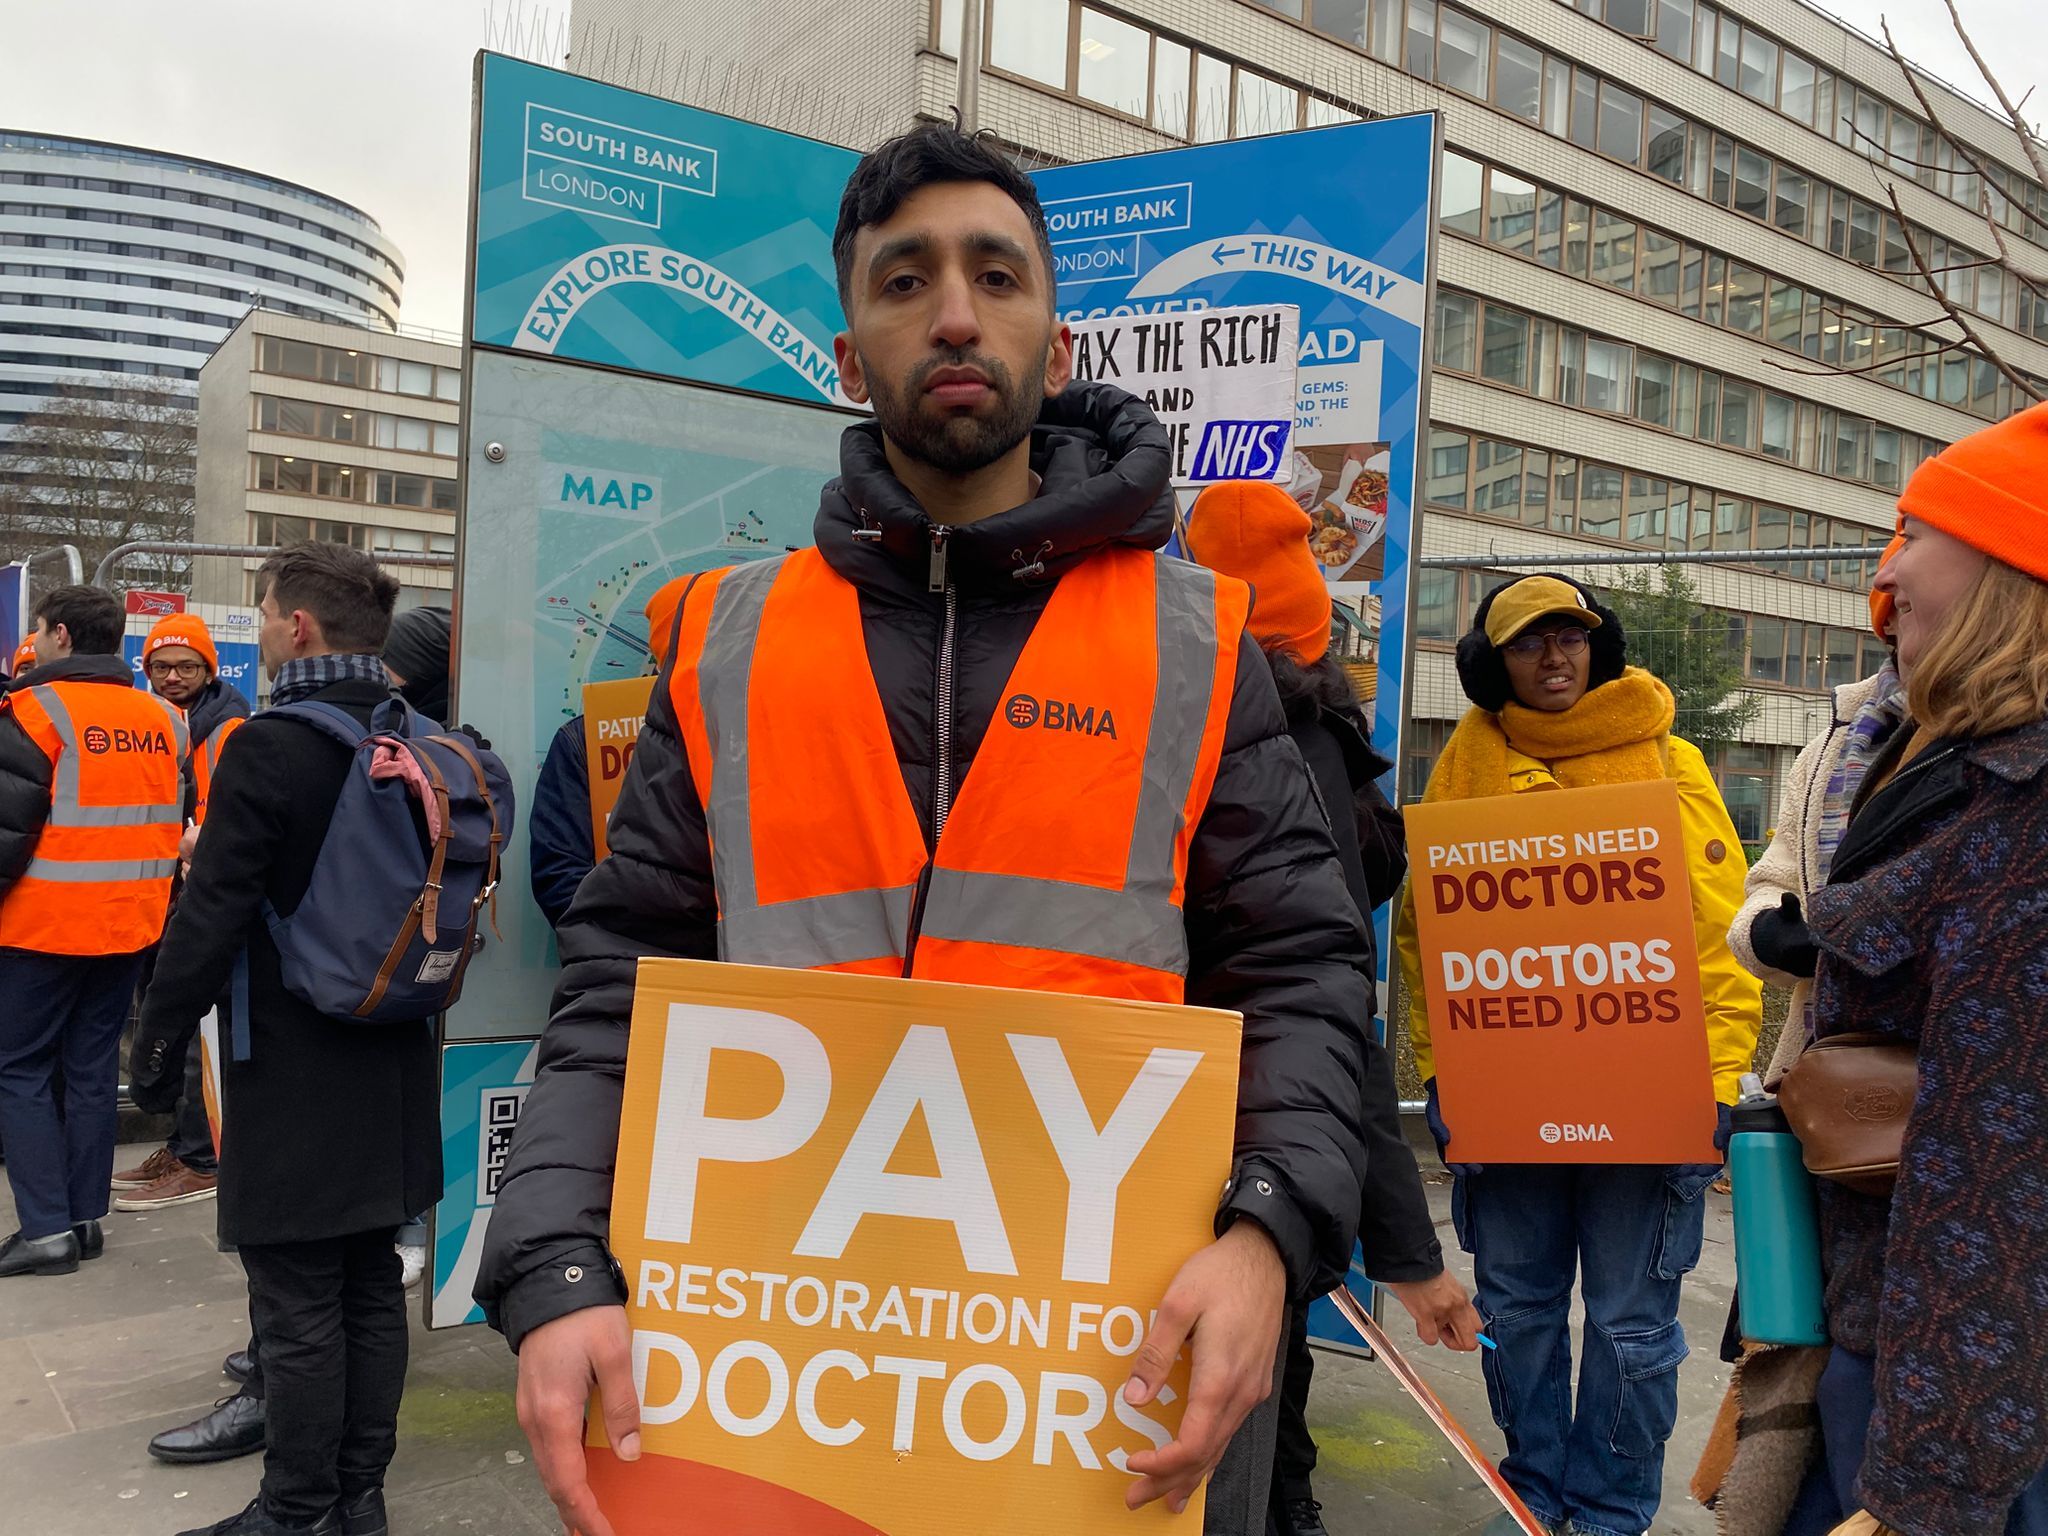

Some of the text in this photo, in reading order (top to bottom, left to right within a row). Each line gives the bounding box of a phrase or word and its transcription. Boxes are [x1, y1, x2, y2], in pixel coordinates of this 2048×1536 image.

[539, 121, 701, 179] SOUTH BANK
[539, 168, 646, 211] LONDON
[1114, 198, 1177, 224] BANK
[1251, 241, 1397, 300] THIS WAY
[526, 250, 840, 397] EXPLORE SOUTH BANK
[1133, 321, 1185, 373] THE
[1200, 313, 1281, 369] RICH
[1298, 328, 1356, 361] AD
[1145, 387, 1194, 412] AND
[1296, 397, 1349, 411] ND THE
[1302, 381, 1348, 395] GEMS:
[1199, 424, 1280, 477] NHS
[561, 472, 653, 510] MAP
[229, 614, 251, 625] NHS
[163, 636, 190, 646] BMA
[1043, 699, 1118, 740] BMA
[113, 729, 171, 756] BMA
[1428, 826, 1660, 868] PATIENTS NEED
[1432, 857, 1666, 914] DOCTORS
[1441, 939, 1676, 992] DOCTORS
[1447, 989, 1681, 1033] NEED JOBS
[644, 1002, 1206, 1285] PAY
[1563, 1123, 1614, 1143] BMA
[636, 1259, 1051, 1349] RESTORATION
[631, 1329, 1178, 1476] DOCTORS
